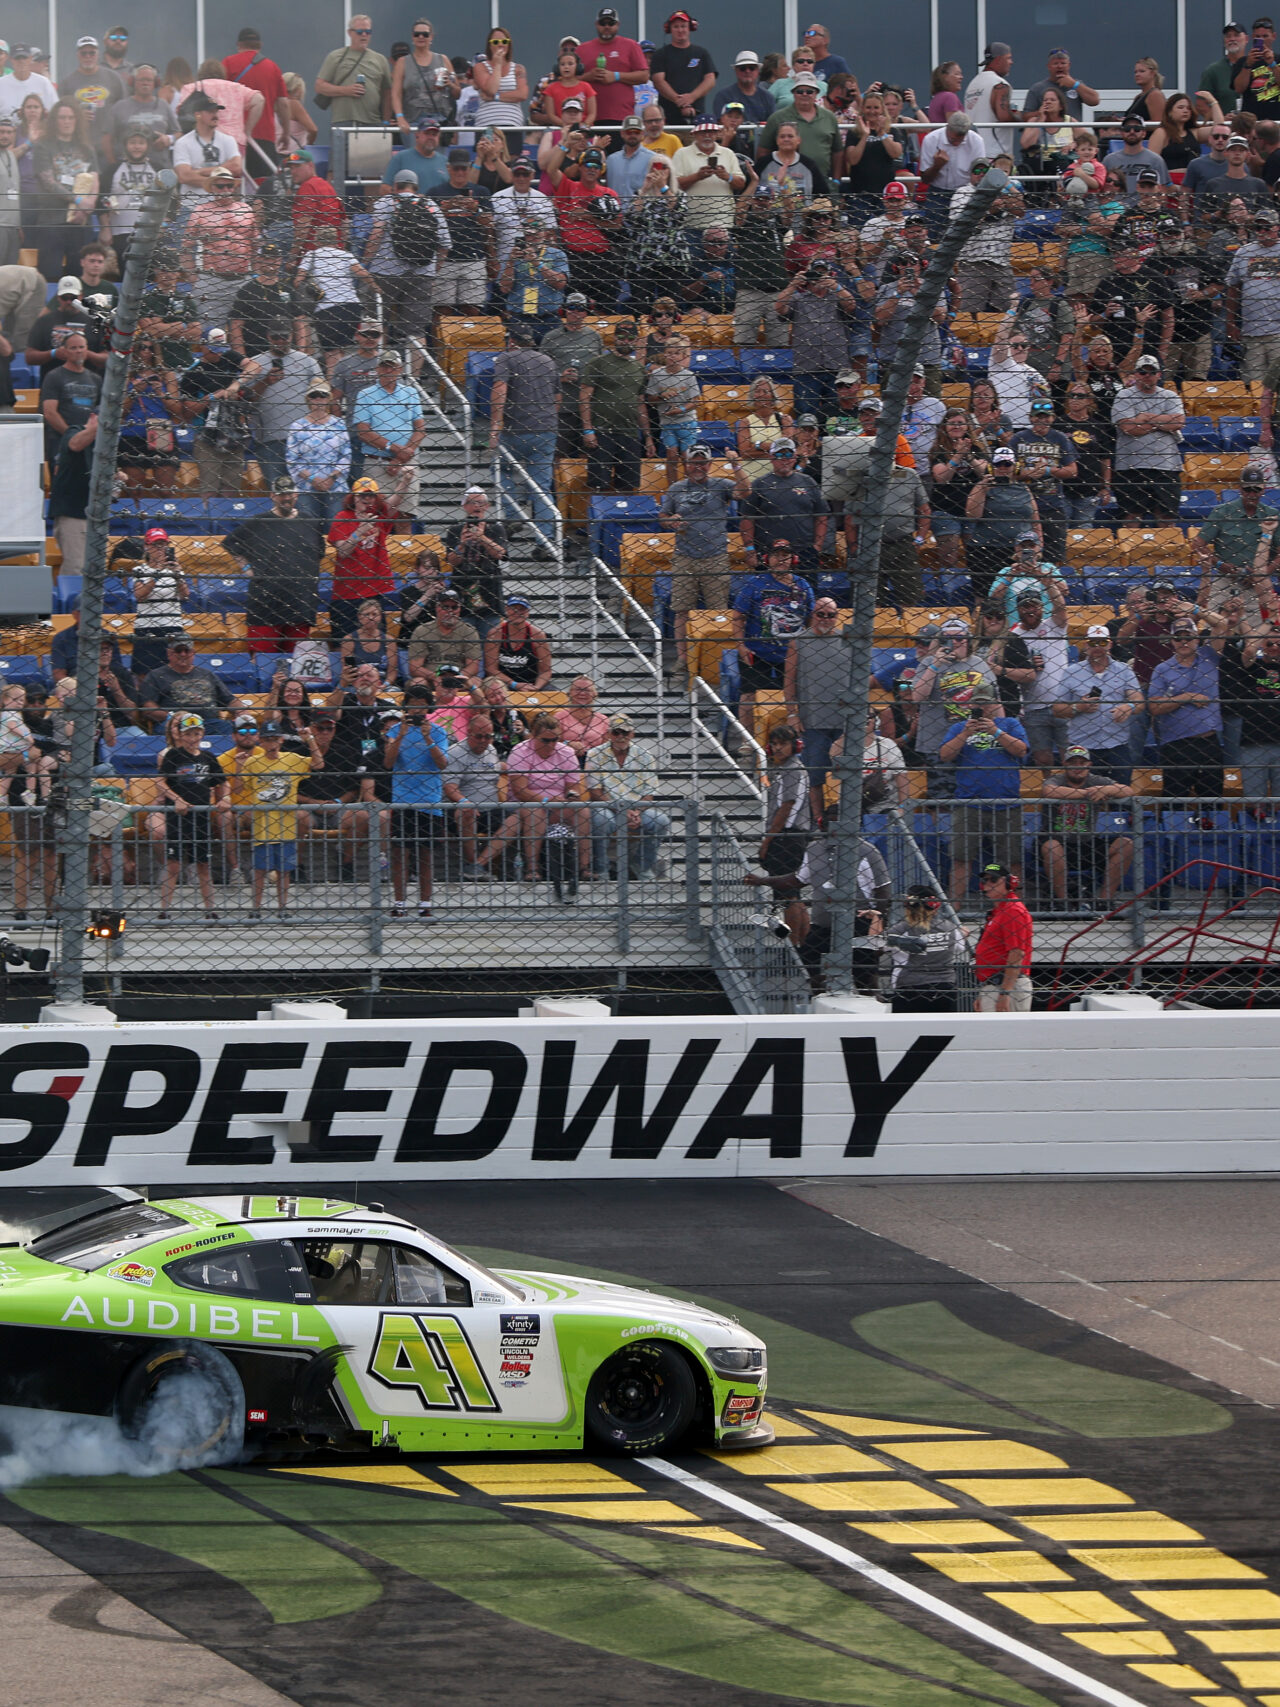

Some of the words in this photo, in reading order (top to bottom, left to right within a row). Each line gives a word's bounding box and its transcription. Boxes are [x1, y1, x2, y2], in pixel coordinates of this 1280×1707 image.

[165, 1232, 235, 1257] ROTO-ROOTER
[109, 1263, 154, 1278] Andy's
[61, 1295, 320, 1343] AUDIBEL
[506, 1319, 533, 1330] xfinity
[621, 1322, 689, 1340] GOODYEAR
[502, 1337, 538, 1345] COMETIC
[366, 1311, 502, 1413] 41
[500, 1362, 531, 1373] Holley
[250, 1412, 265, 1420] SEM
